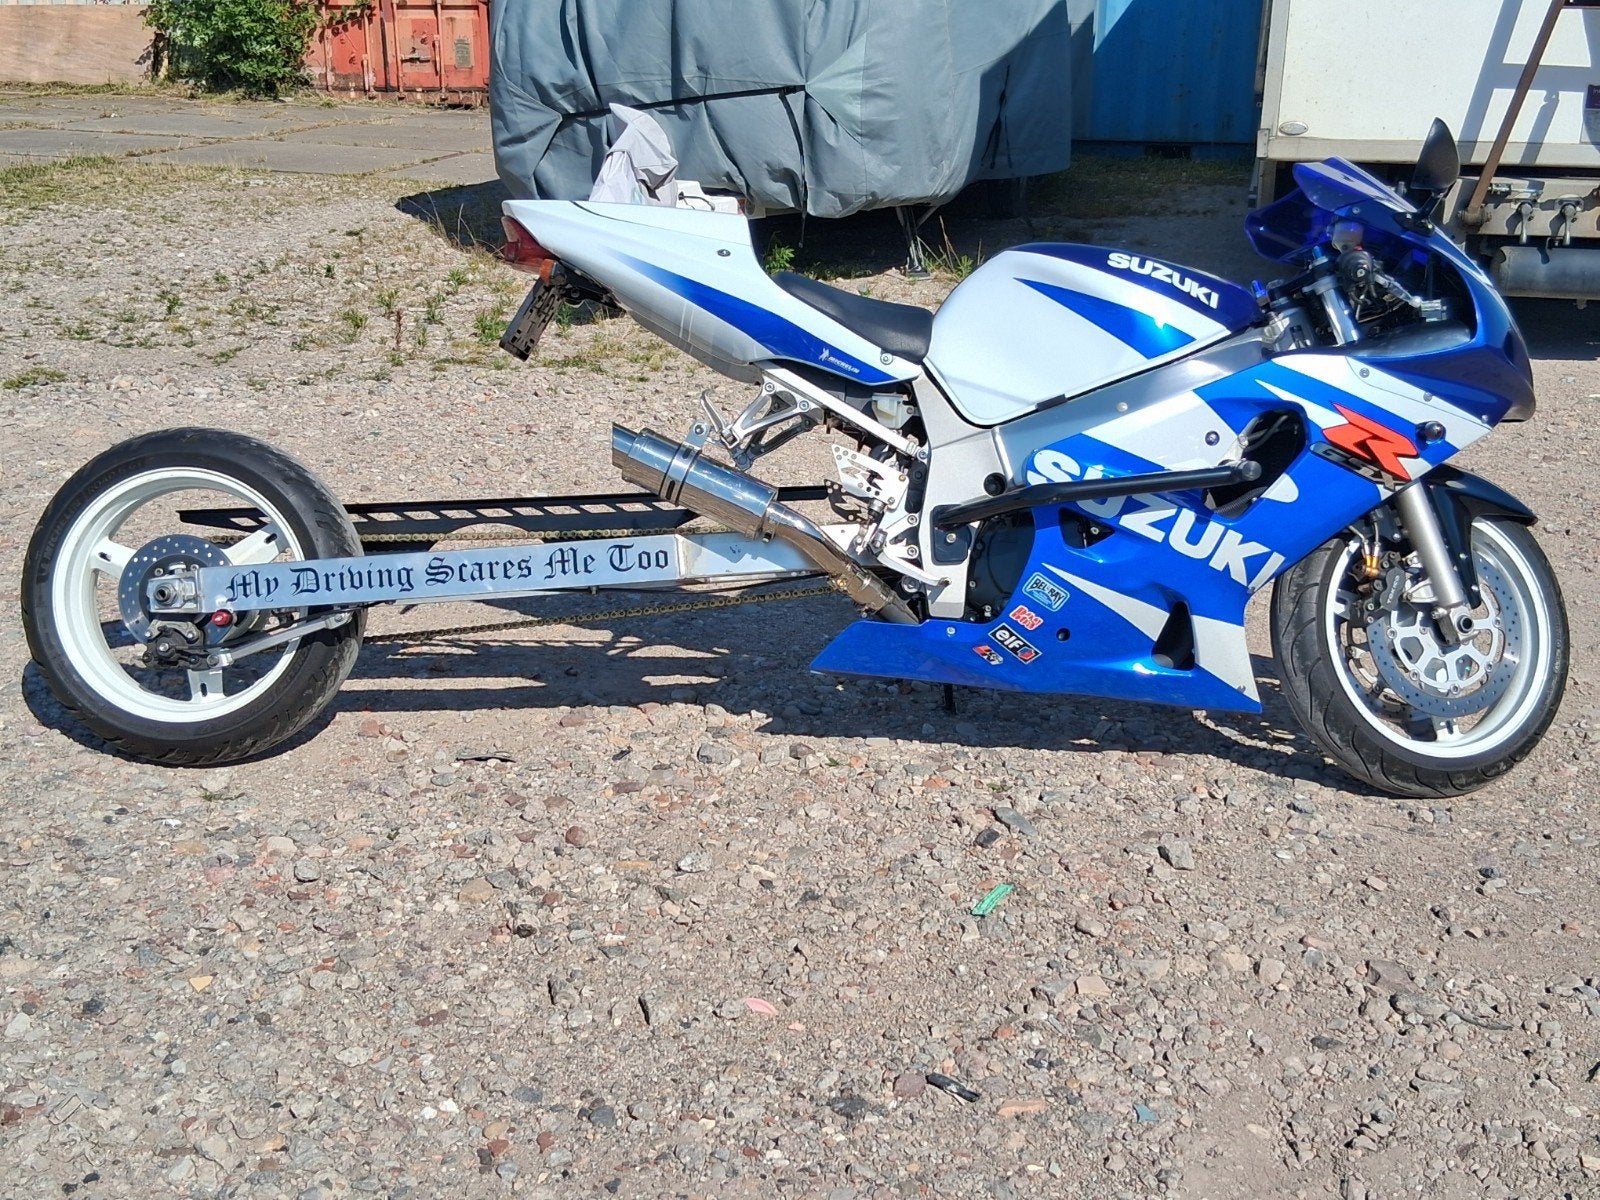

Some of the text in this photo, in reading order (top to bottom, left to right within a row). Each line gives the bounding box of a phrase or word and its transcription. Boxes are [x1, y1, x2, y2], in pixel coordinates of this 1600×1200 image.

[1106, 252, 1220, 309] SUZUKI
[1321, 401, 1420, 483] R
[1026, 449, 1287, 593] SUZUKI
[225, 542, 670, 603] My Driving Scares Me Too
[995, 629, 1024, 649] elf
